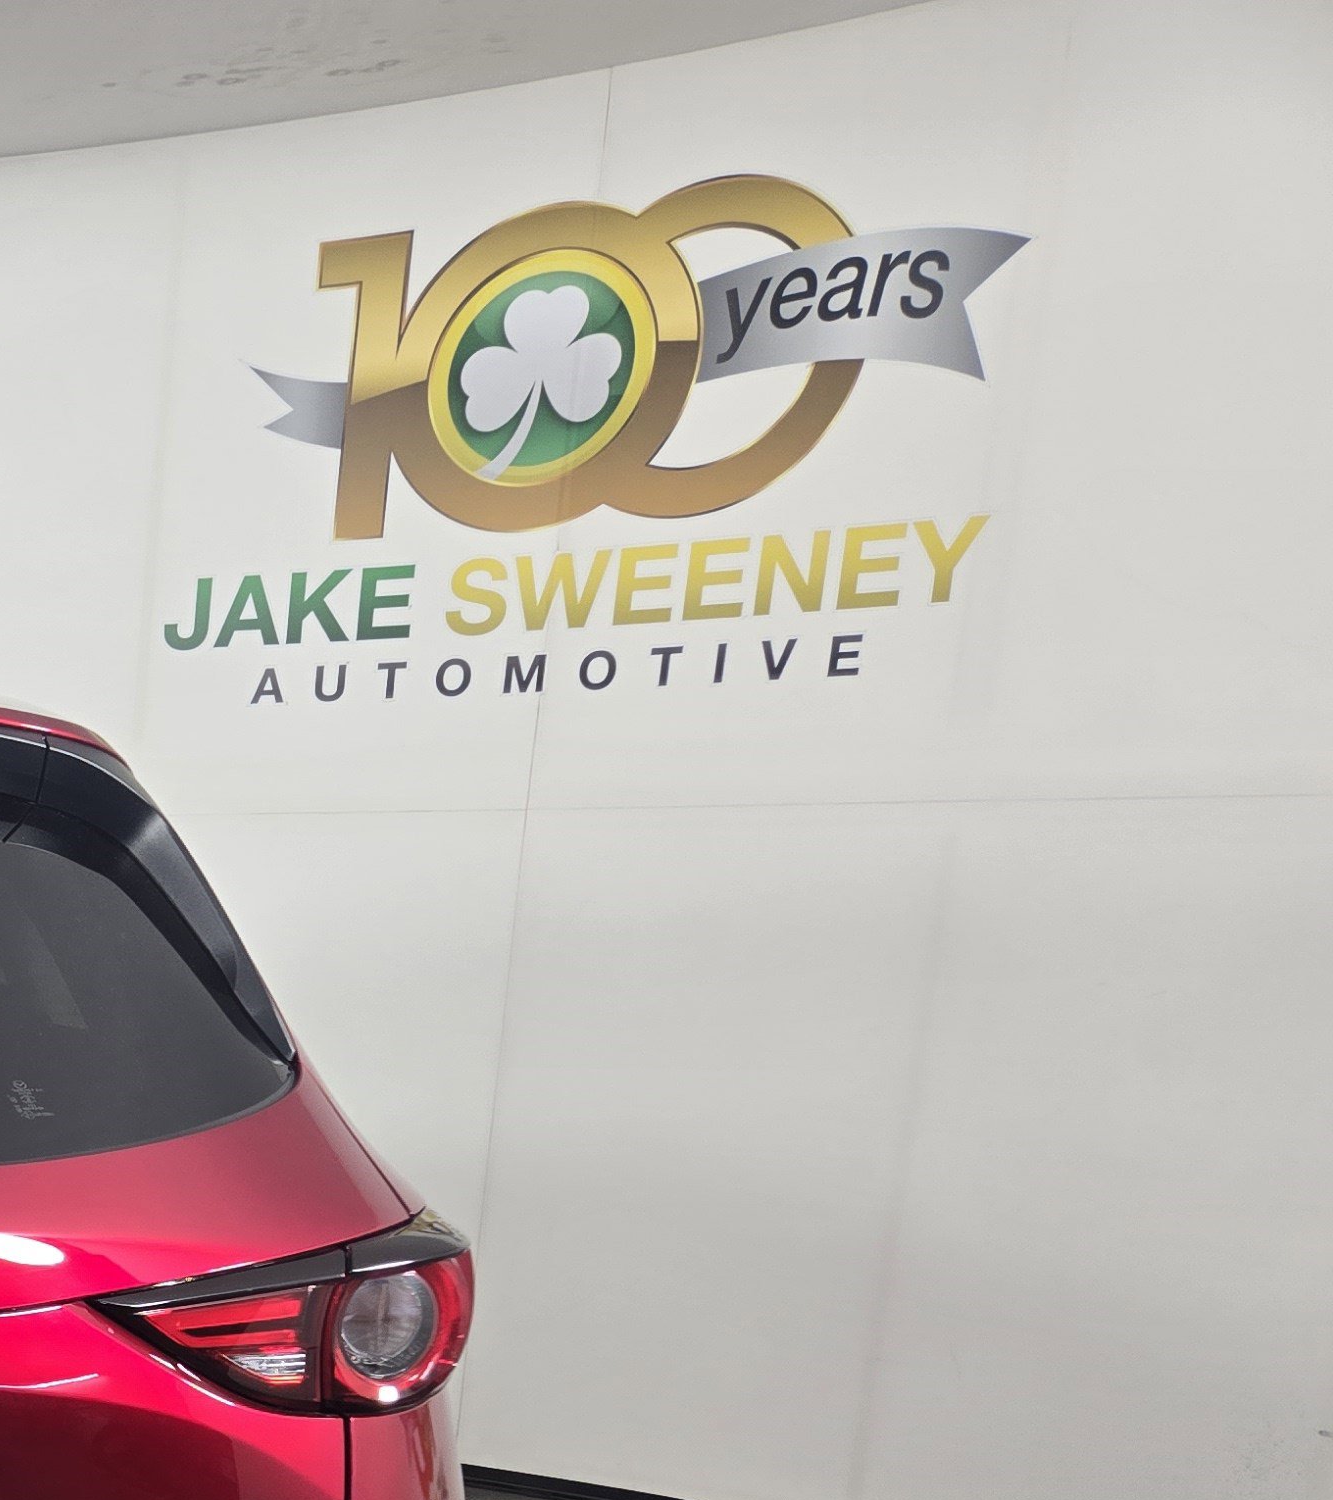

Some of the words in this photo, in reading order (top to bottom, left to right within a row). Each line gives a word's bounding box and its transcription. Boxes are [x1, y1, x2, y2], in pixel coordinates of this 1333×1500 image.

[318, 173, 865, 541] 100
[715, 247, 950, 364] years
[163, 564, 417, 652] JAKE
[444, 513, 992, 638] SWEENEY
[250, 633, 866, 706] AUTOMOTIVE
